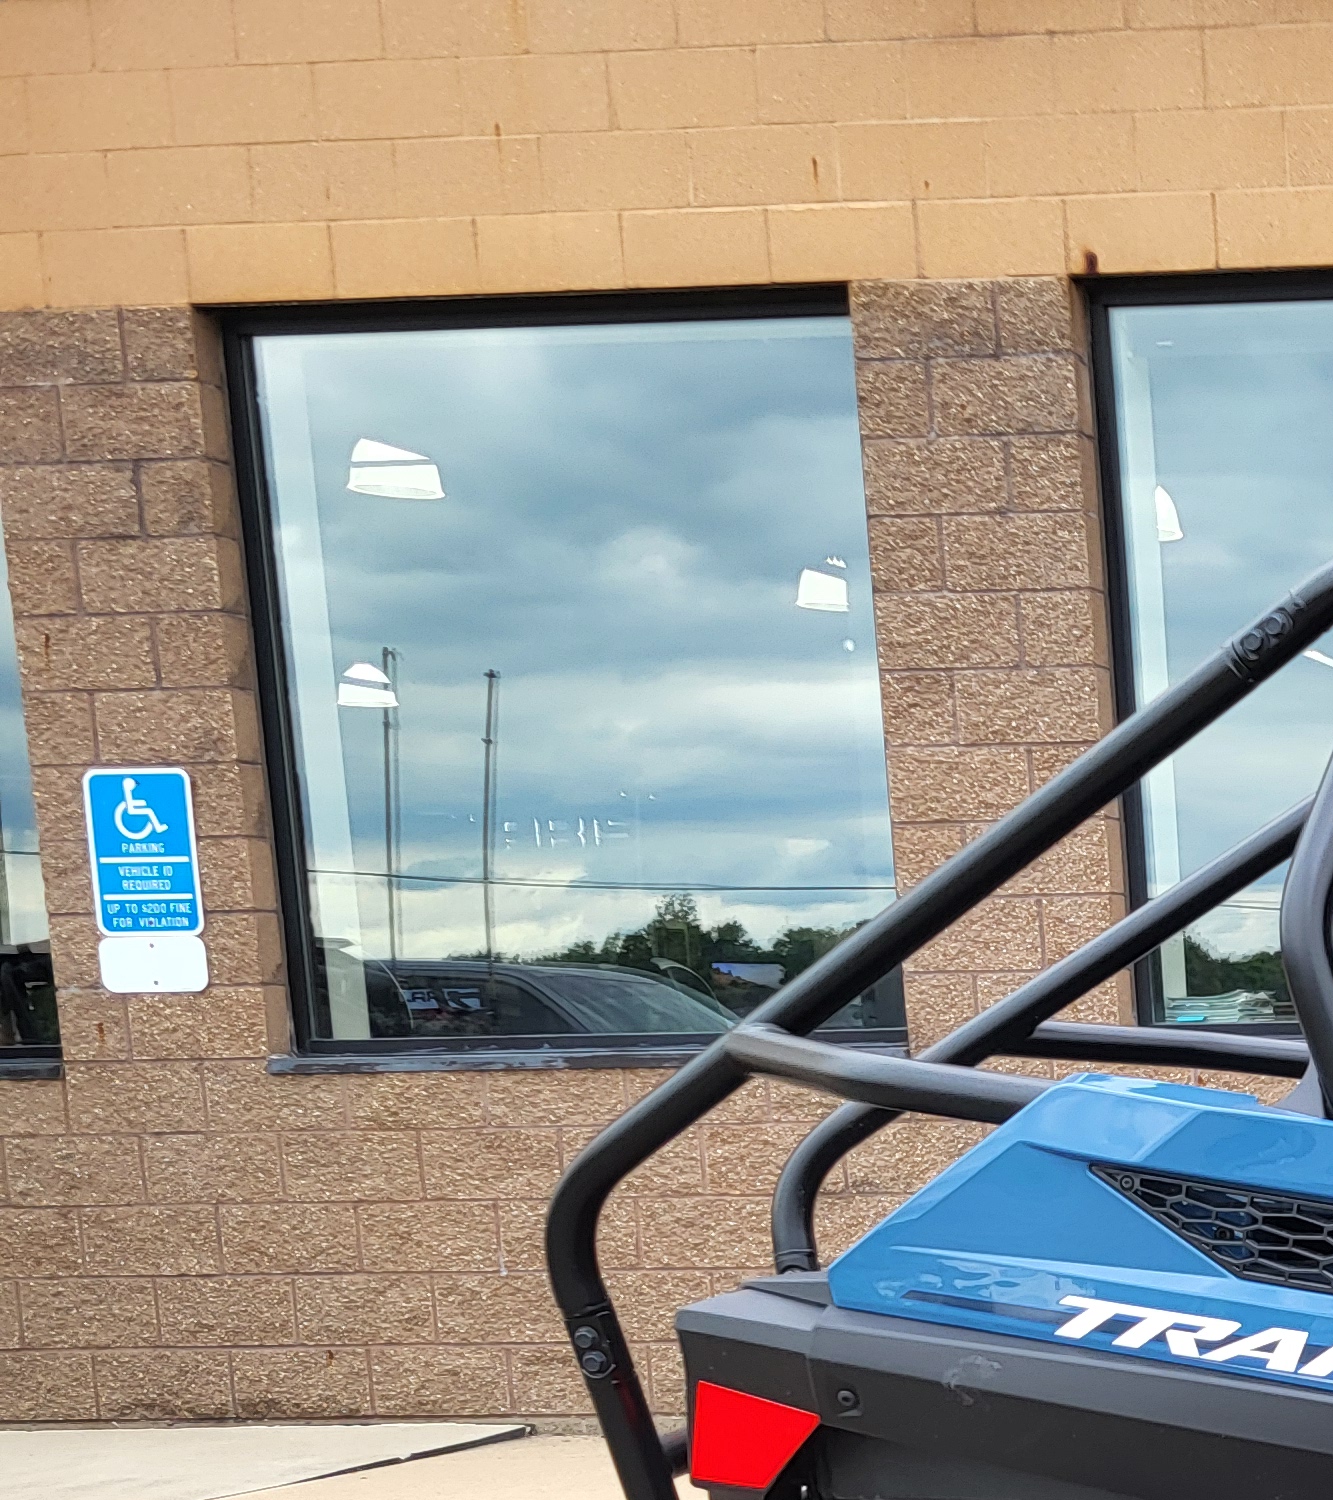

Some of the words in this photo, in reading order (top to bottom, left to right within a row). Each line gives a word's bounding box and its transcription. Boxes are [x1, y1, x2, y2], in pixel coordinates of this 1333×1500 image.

[122, 843, 165, 854] PARKING
[118, 866, 159, 877] VEHICLE
[162, 866, 173, 876] ID
[122, 880, 171, 891] REQUIRED
[107, 904, 120, 915] UP
[125, 903, 138, 914] TO
[142, 903, 167, 914] $200
[170, 902, 192, 913] FINE
[113, 917, 133, 928] FOR
[139, 916, 189, 928] VIOLATION
